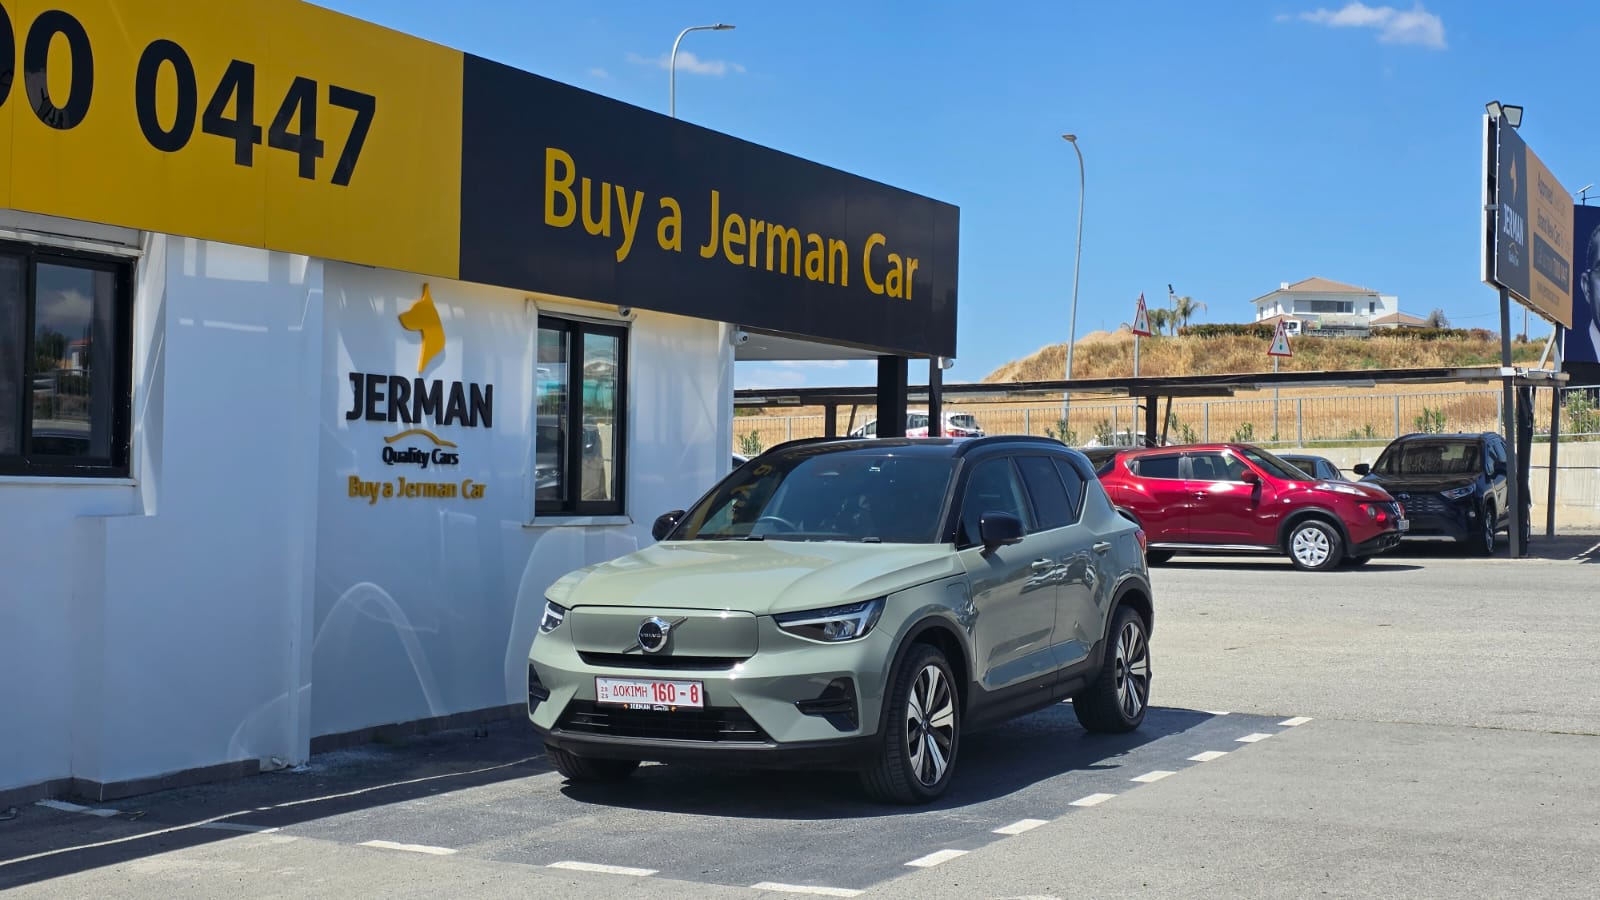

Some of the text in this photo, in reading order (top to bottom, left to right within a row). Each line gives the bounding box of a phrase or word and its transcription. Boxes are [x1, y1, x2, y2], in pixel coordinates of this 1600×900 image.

[0, 3, 376, 187] 0 0447
[544, 147, 919, 301] Buy a Jerman Car
[346, 372, 493, 428] JERMAN
[382, 446, 459, 468] Quality Cars
[348, 475, 487, 505] Buy a Jerman Car
[651, 682, 675, 702] 160
